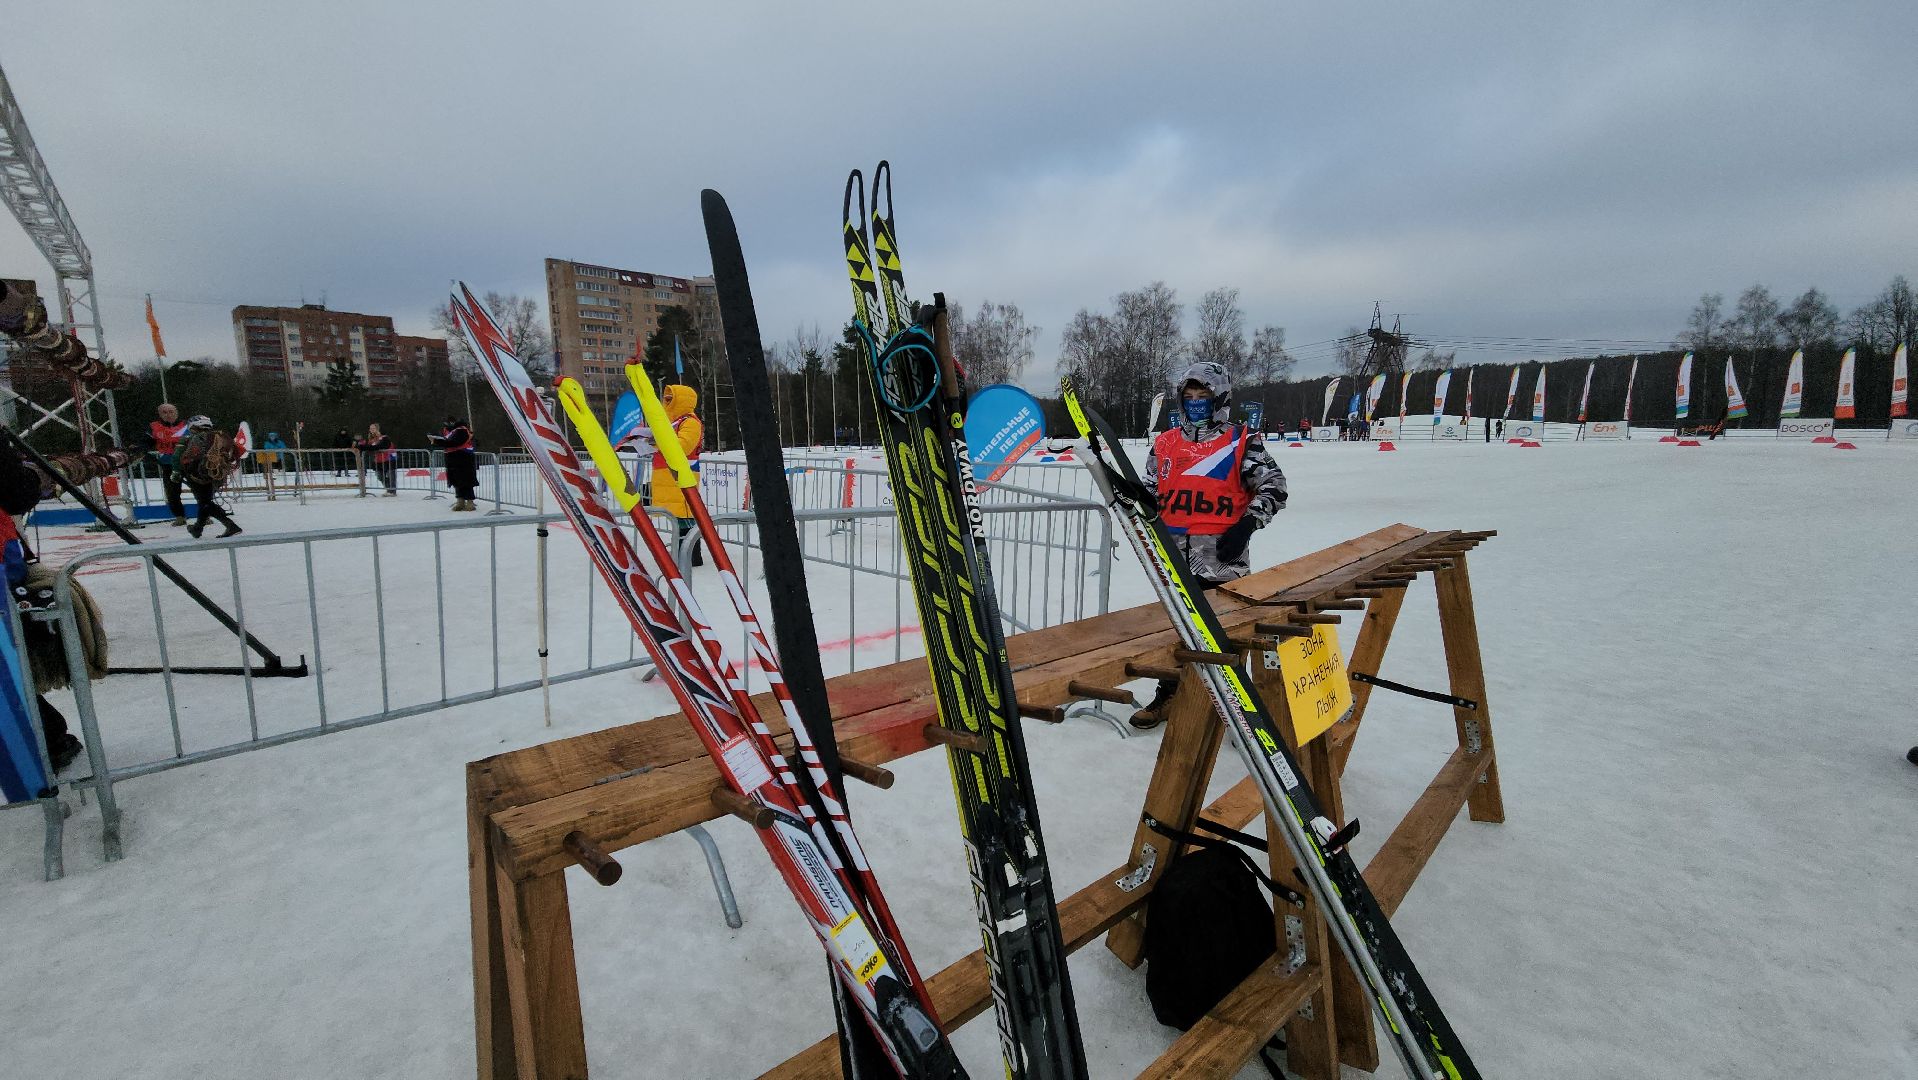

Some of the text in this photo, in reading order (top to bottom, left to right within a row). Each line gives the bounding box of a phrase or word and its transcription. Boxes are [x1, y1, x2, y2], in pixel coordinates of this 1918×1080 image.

[973, 406, 1031, 464] АЛЛЕЛЬНЫЕ
[999, 418, 1039, 454] ПЕРИЛА
[1781, 424, 1824, 433] BOSCO
[955, 438, 985, 538] NORDWAY
[1299, 632, 1325, 660] ЗОНА
[1292, 652, 1340, 698] ХРАНЕНИЯ
[1316, 688, 1339, 719] ЛЫЖ
[789, 835, 840, 909] NANOSONIC
[860, 954, 878, 979] TOKO
[962, 836, 1019, 1074] FISCHER
